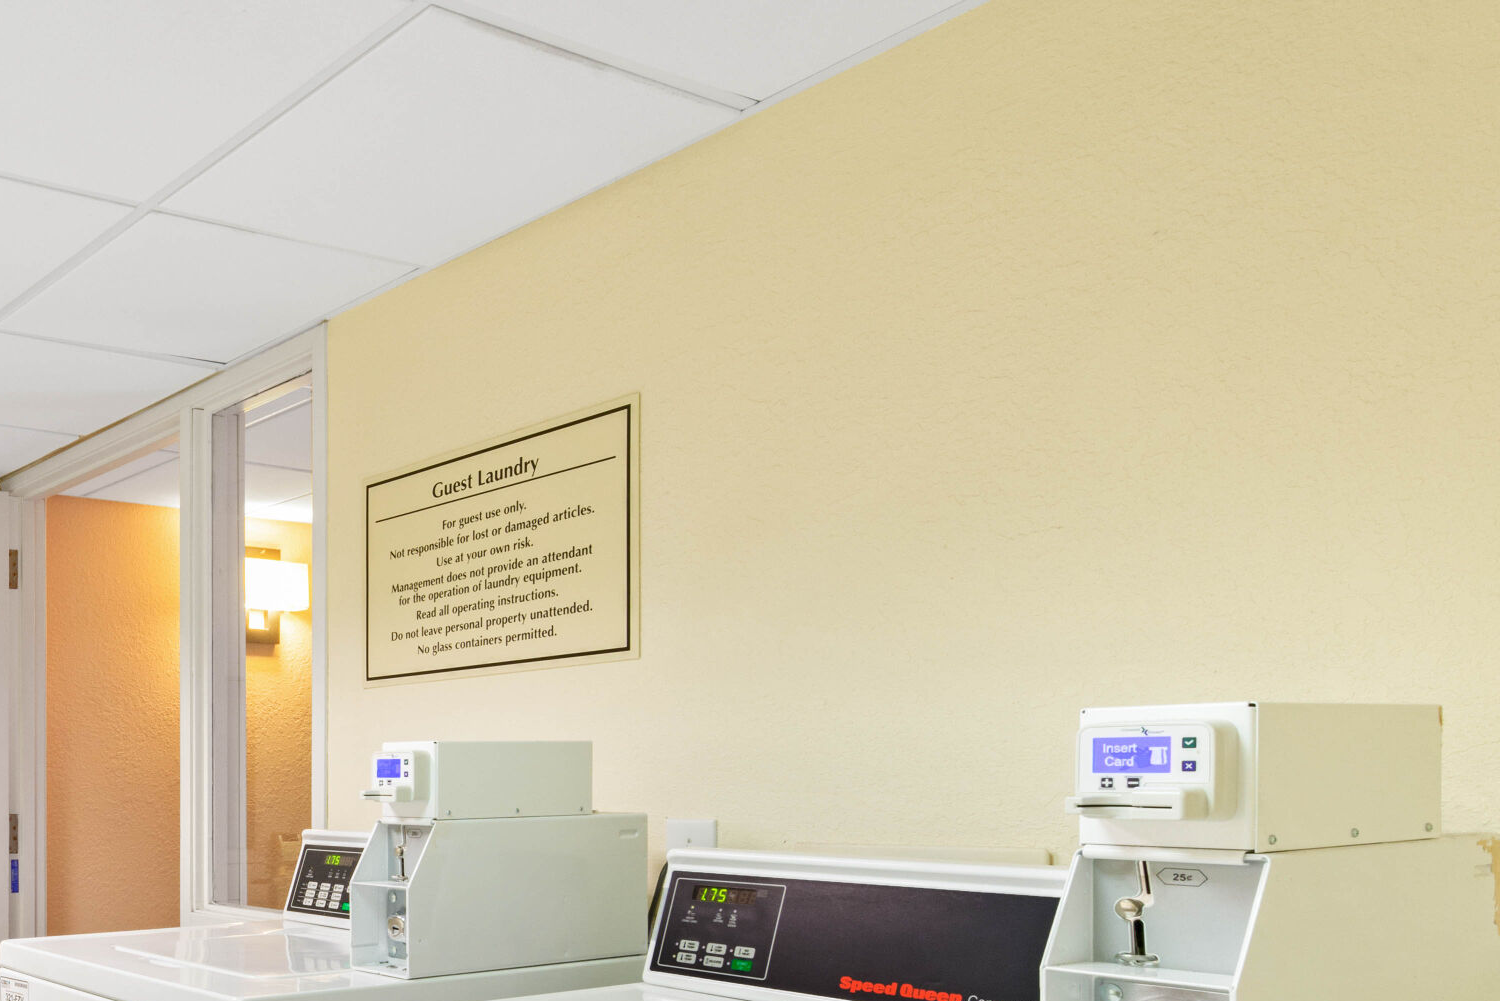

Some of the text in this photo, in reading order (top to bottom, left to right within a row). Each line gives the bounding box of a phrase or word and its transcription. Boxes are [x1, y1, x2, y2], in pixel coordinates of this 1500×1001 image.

[432, 457, 539, 499] Guest Laundry
[443, 500, 527, 530] For guest use only.
[390, 505, 595, 560] Not responsible for lost or damaged articles.
[437, 537, 534, 567] Use at your own risk.
[392, 544, 593, 593] Management does not provide an attendant
[399, 563, 582, 606] for the operation of laundry equipment.
[417, 589, 559, 621] Read all operating instructions.
[391, 600, 593, 642] Do not leave personal property unattended.
[418, 625, 557, 656] No glass containers permitted.
[1102, 743, 1138, 754] Insert
[1104, 755, 1135, 767] Card
[839, 976, 898, 996] Speed
